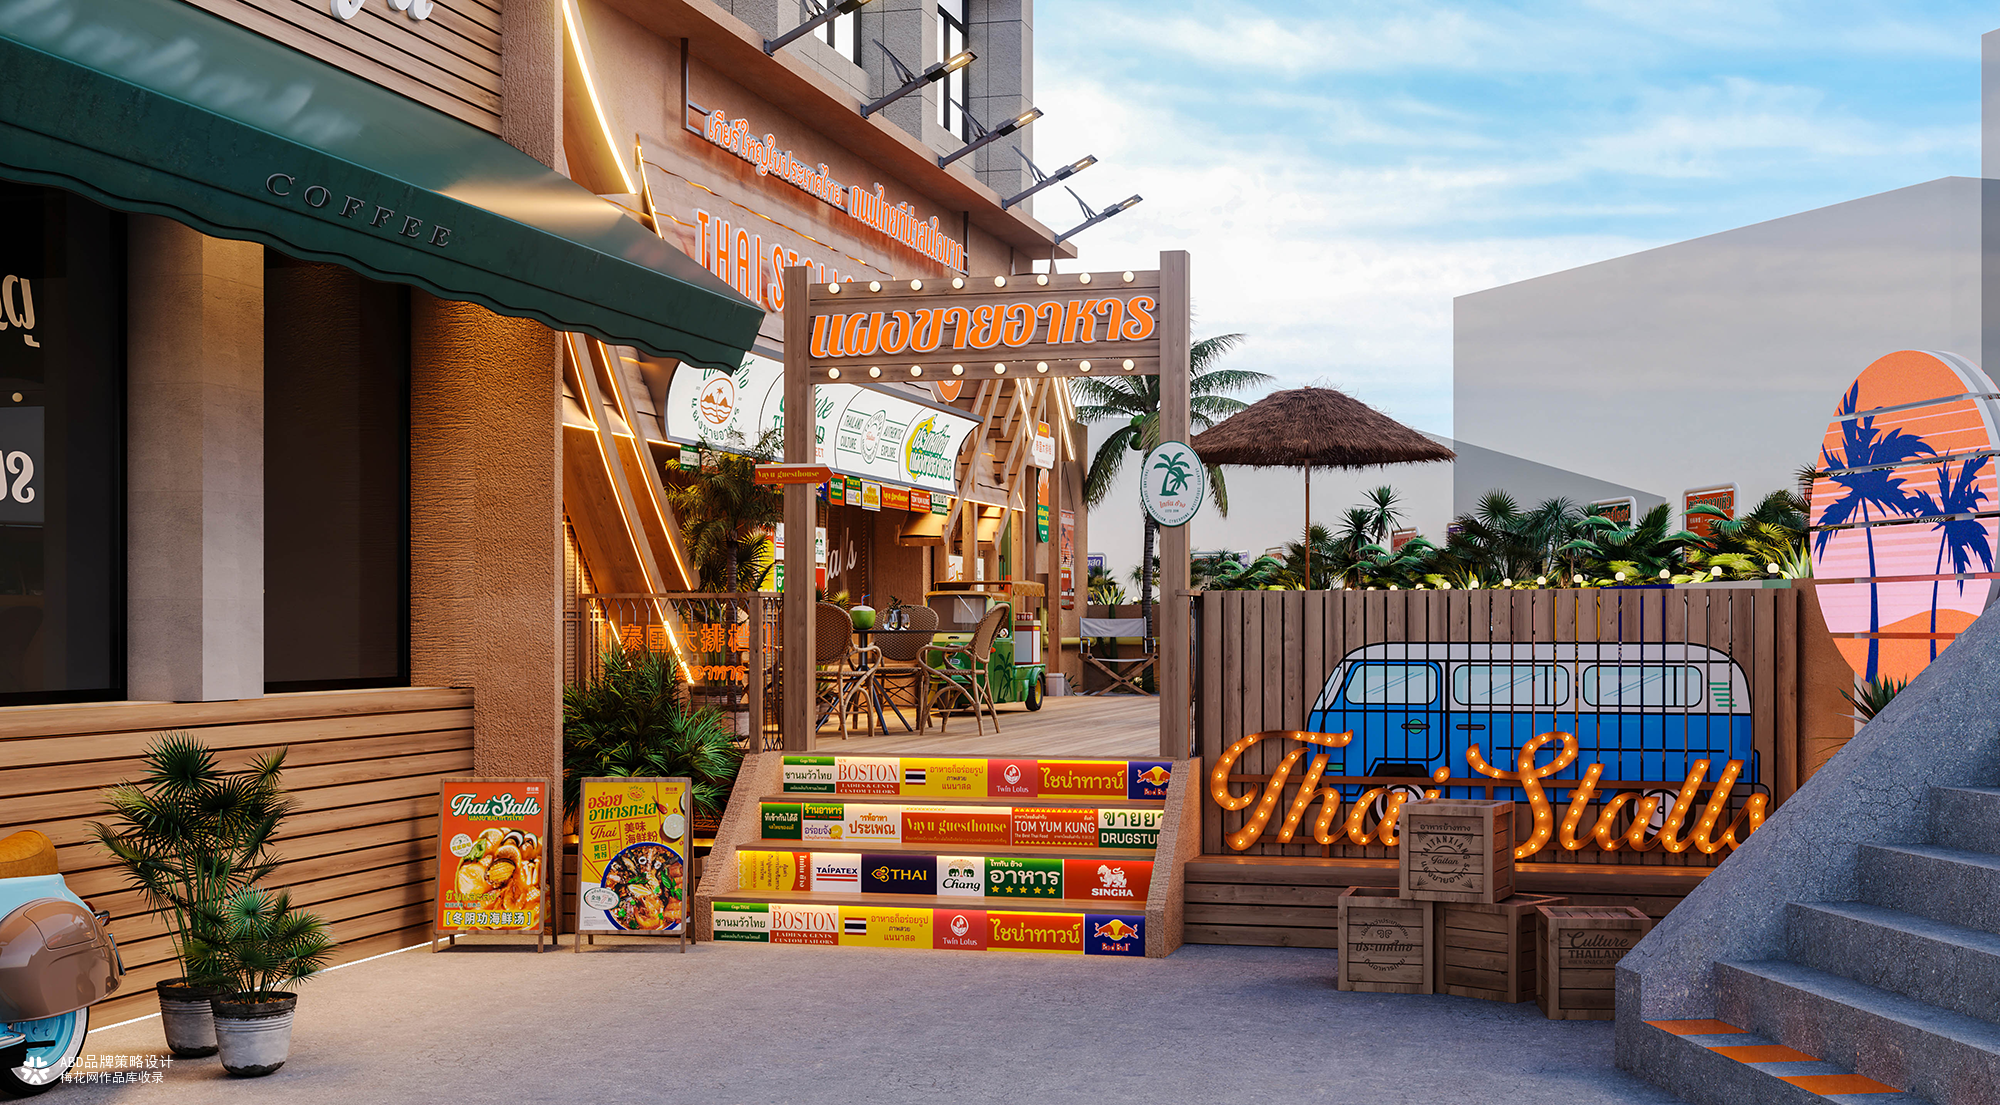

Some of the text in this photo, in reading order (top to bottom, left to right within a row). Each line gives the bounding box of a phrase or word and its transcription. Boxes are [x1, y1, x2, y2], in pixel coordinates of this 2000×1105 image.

[265, 172, 454, 248] COFFEE
[694, 208, 761, 304] THAI
[810, 296, 1157, 359] แผงขายอาหาร
[777, 470, 820, 480] guesthouse
[838, 763, 898, 782] BOSTON
[1040, 767, 1124, 790] ไชน่าทาวน์
[451, 792, 542, 817] Thai Stalls
[588, 791, 623, 809] อร่อย
[588, 802, 657, 822] อาหารทะเล
[590, 824, 617, 840] Thai
[624, 820, 646, 835] 美味
[907, 818, 1007, 835] Vayu guesthouse
[1014, 820, 1095, 834] TOM YUM KUNG
[625, 830, 658, 845] 海鲜粉
[1101, 832, 1159, 845] DRUGSTU
[1420, 835, 1471, 860] TAITANXIANG
[1431, 854, 1459, 865] Taitan
[889, 869, 927, 881] THAI
[989, 869, 1061, 886] อาหาร
[942, 877, 981, 892] Chang
[1091, 887, 1134, 898] SINGHA
[772, 911, 836, 931] BOSTON
[990, 918, 1081, 944] ไชน่าทาวน์
[960, 938, 978, 946] Lotus
[1101, 943, 1130, 952] Red Bull
[1355, 939, 1413, 952] ประเทศไทย
[1567, 931, 1629, 949] Culture
